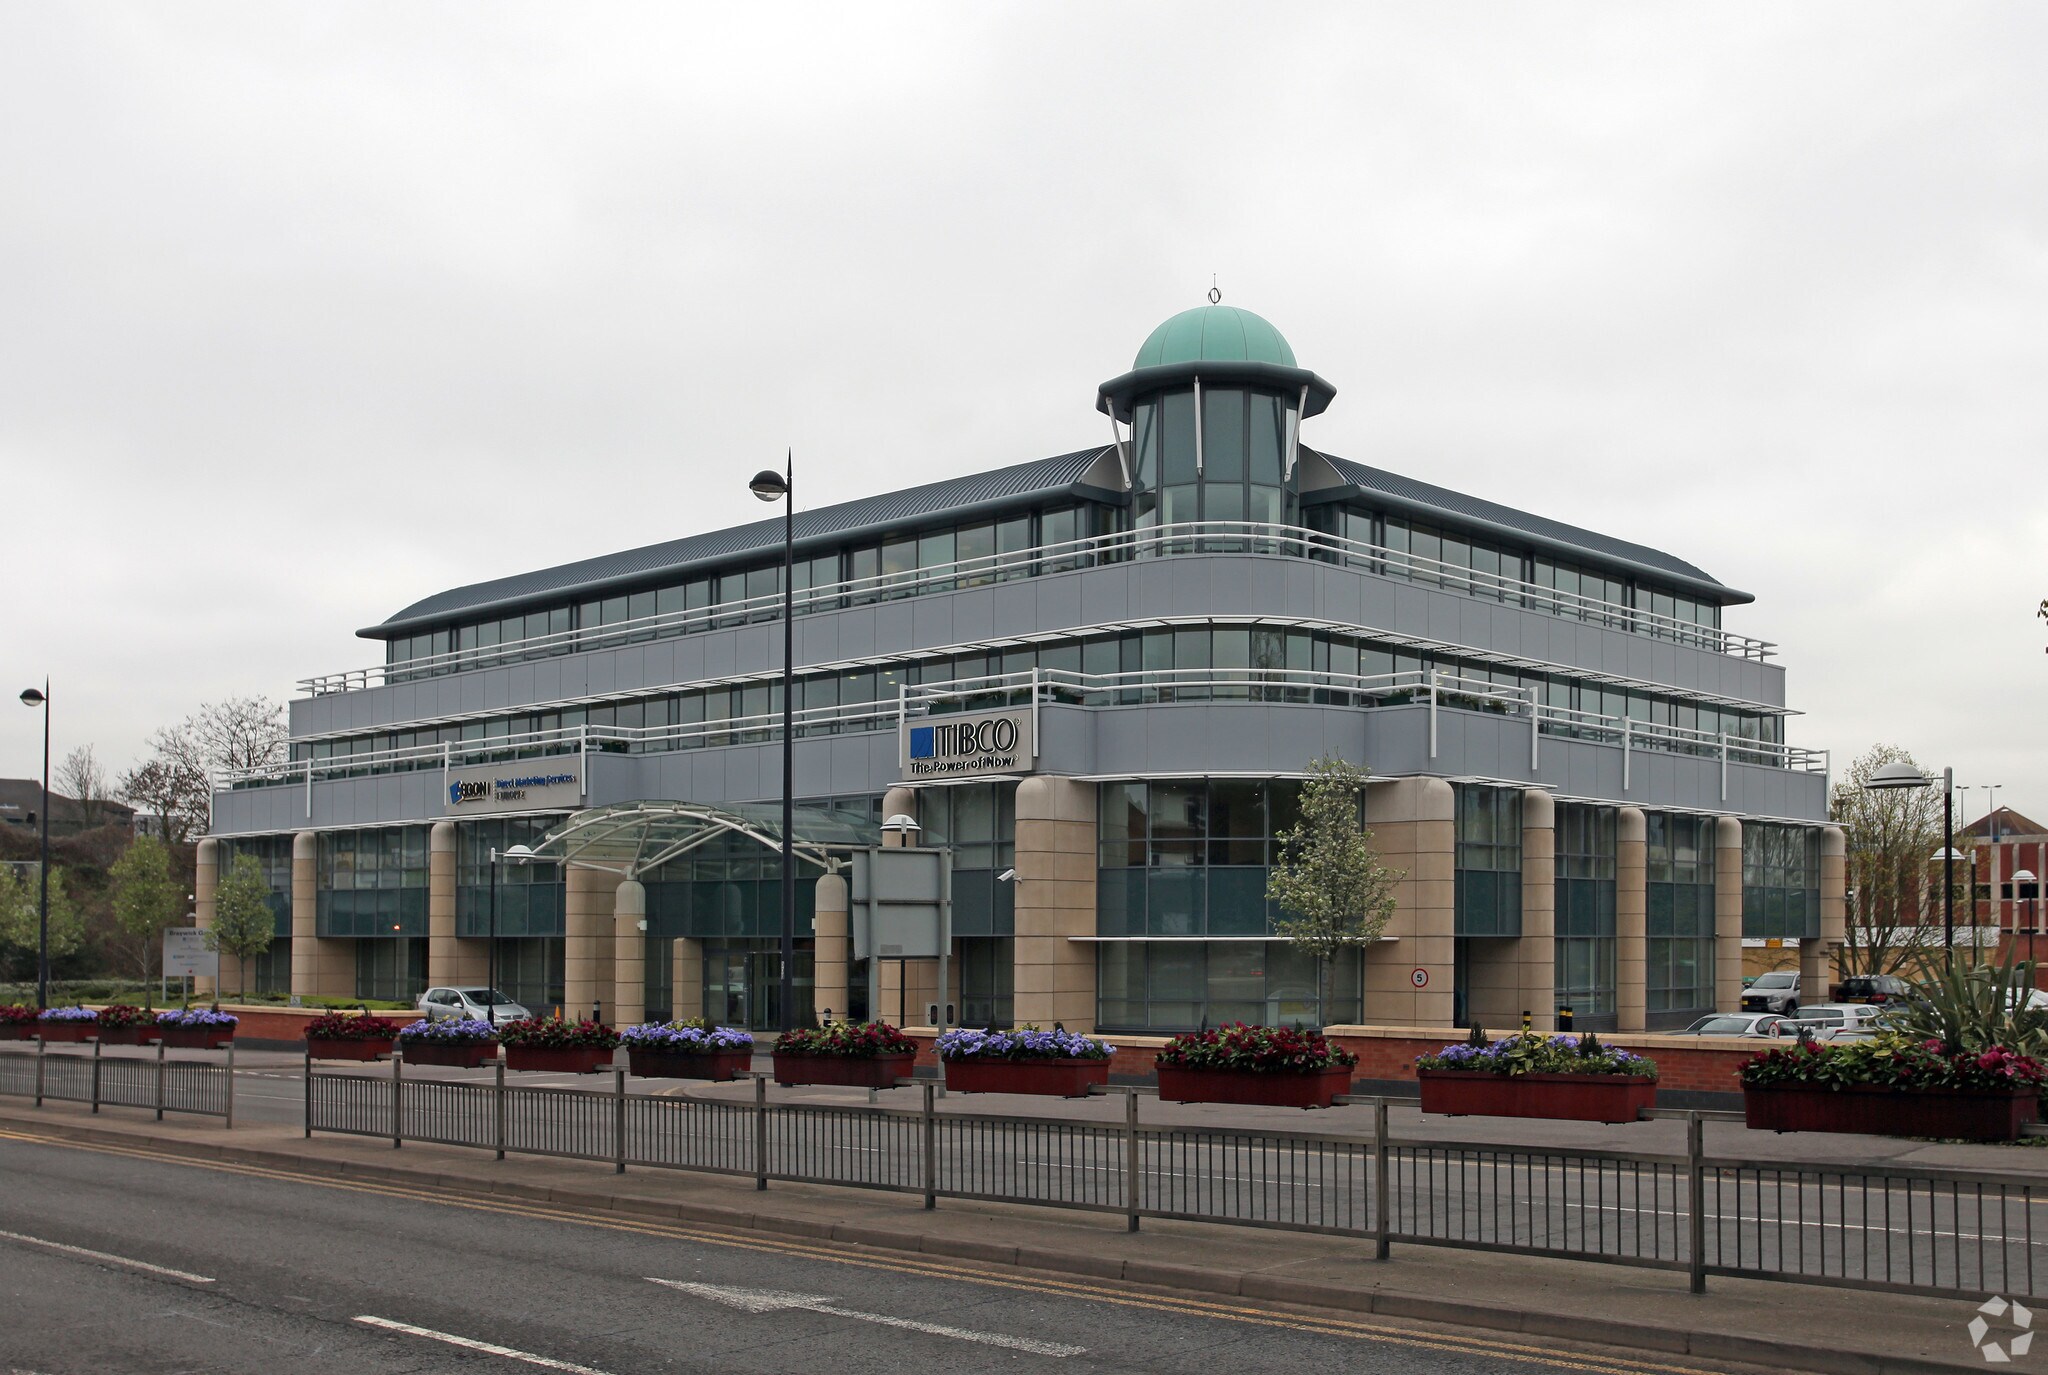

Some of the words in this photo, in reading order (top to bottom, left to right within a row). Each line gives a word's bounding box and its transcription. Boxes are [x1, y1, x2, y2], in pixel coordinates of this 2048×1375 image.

[910, 762, 932, 774] The
[934, 760, 969, 773] Power
[971, 756, 985, 769] of
[496, 779, 515, 789] Direct
[515, 776, 548, 788] Marketing
[548, 774, 576, 785] Services
[497, 790, 526, 801] EUROPE
[1416, 973, 1423, 982] 5
[1771, 1028, 1776, 1037] 5
